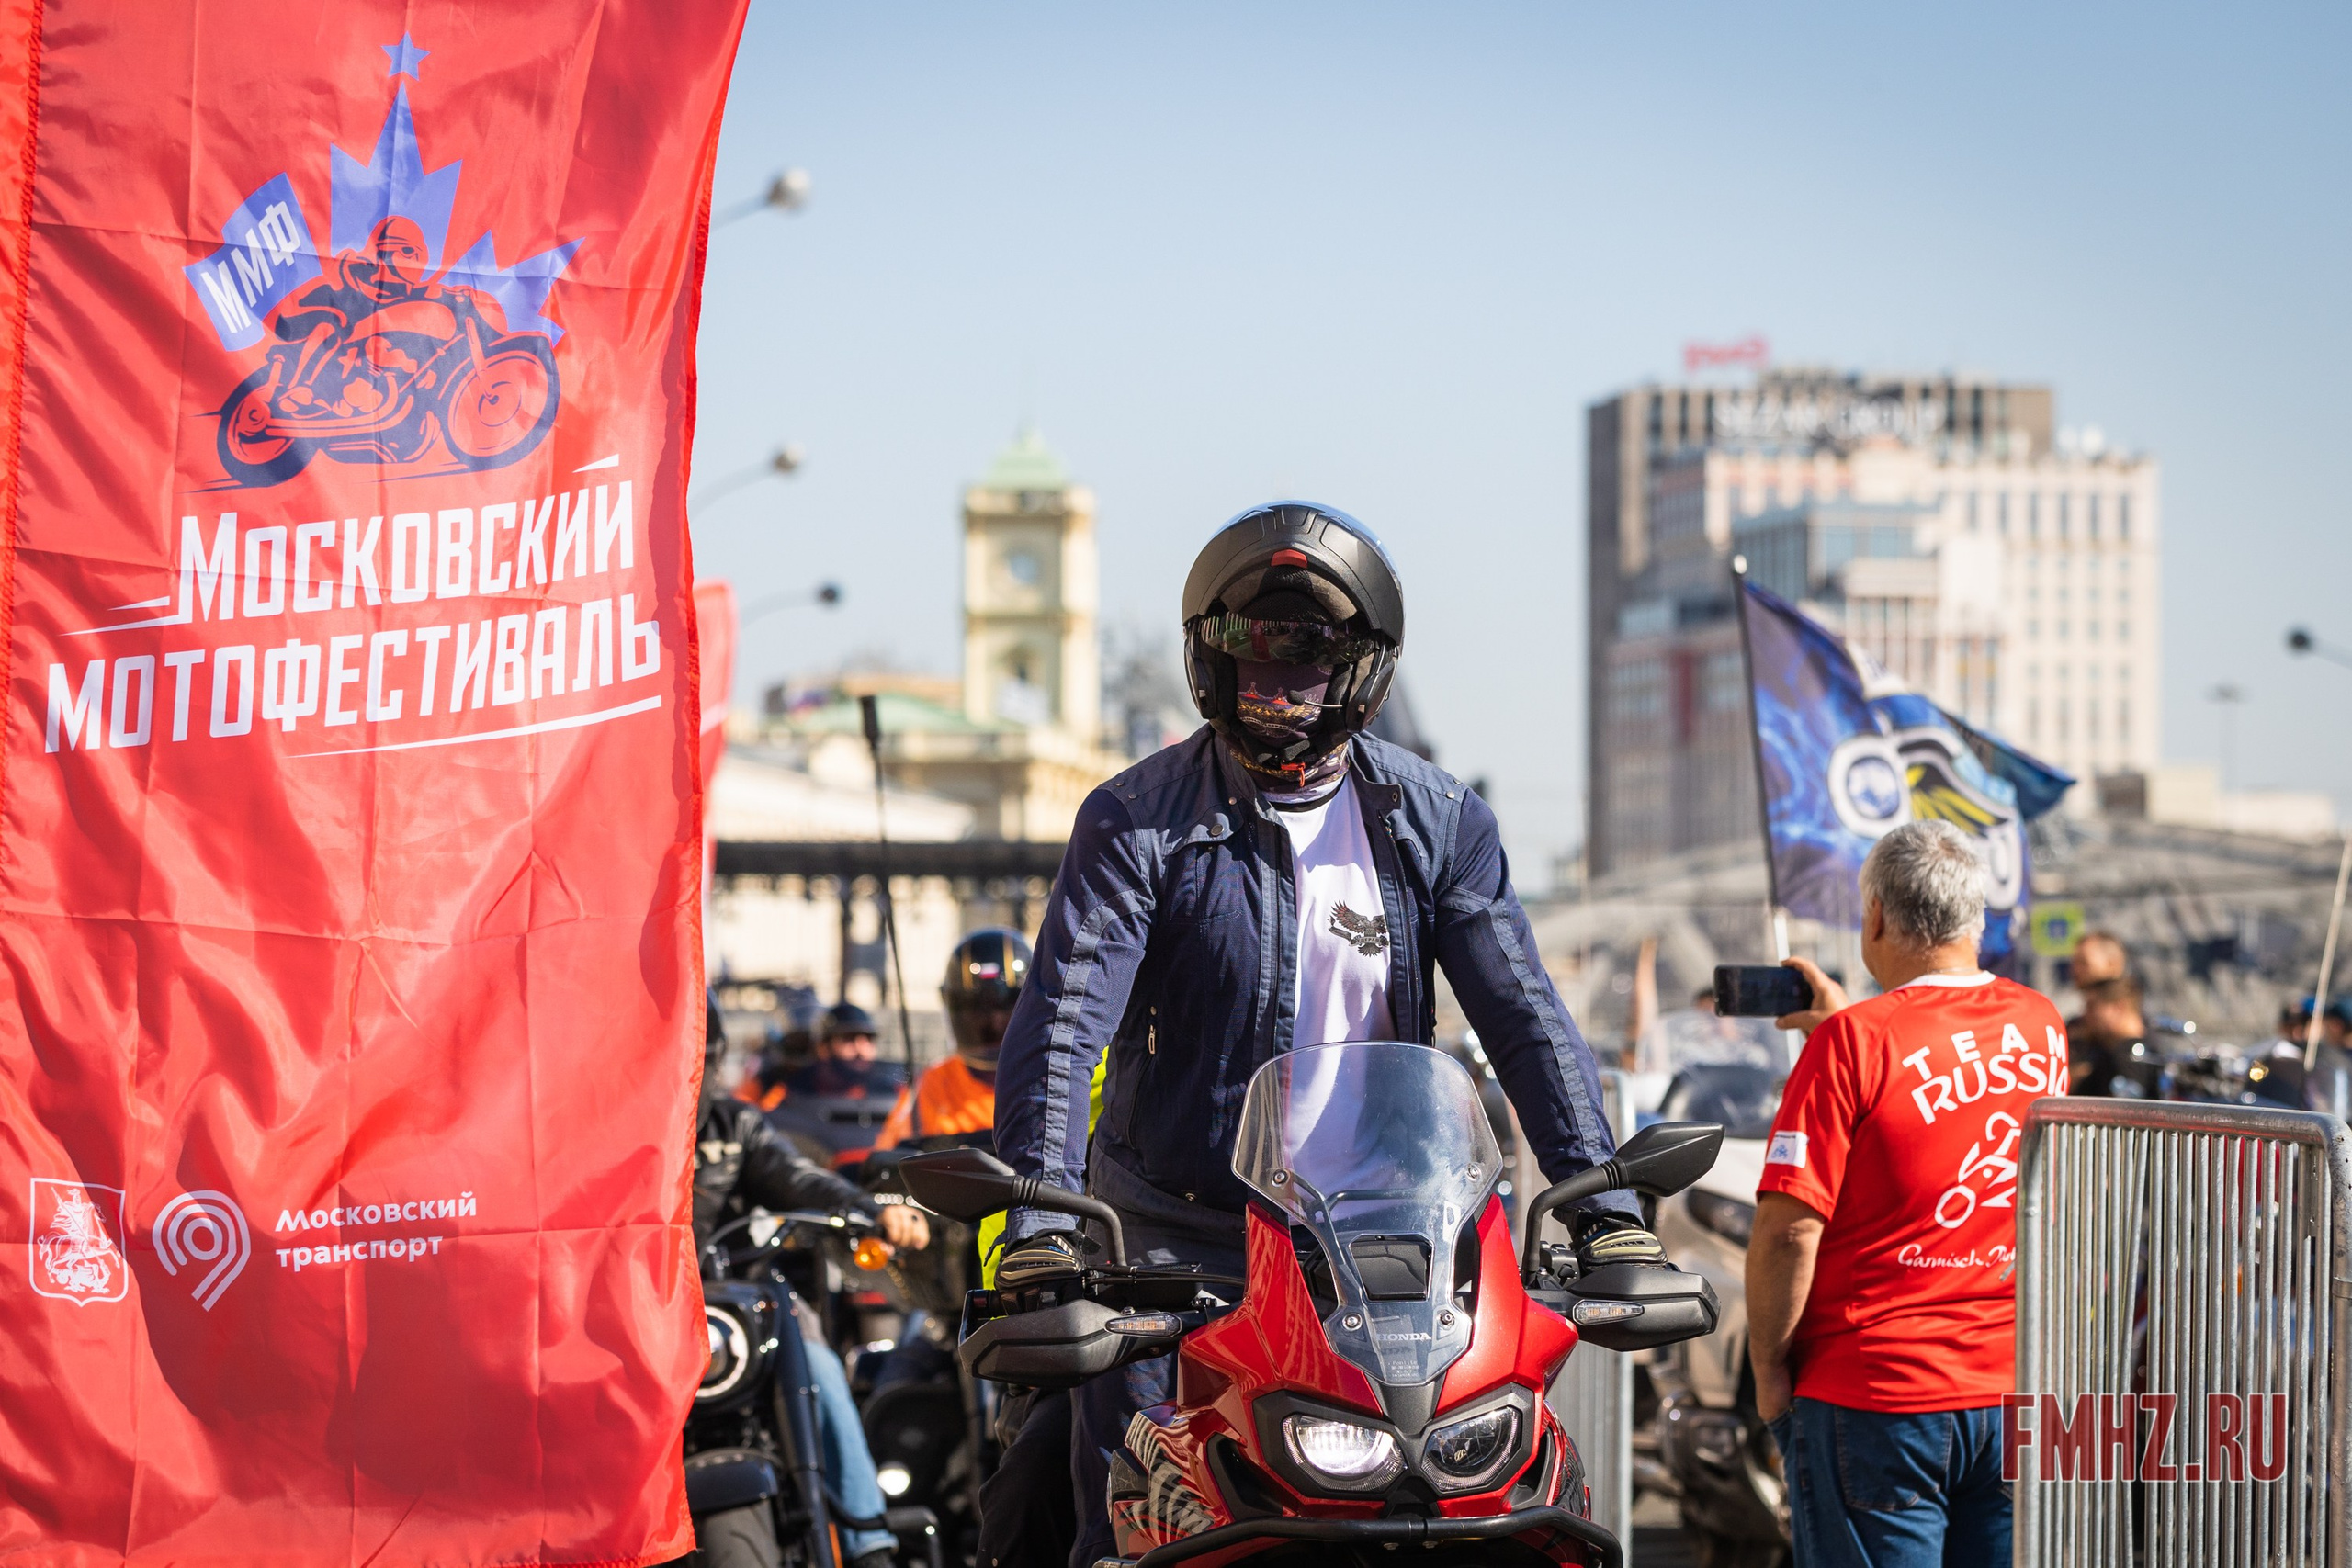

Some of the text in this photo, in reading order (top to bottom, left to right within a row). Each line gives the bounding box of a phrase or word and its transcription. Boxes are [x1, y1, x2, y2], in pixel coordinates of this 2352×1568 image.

[200, 201, 301, 333] ММФ
[45, 593, 662, 753] МОТОФЕСТИВАЛЬ
[1902, 1023, 2067, 1082] TEAM
[275, 1190, 477, 1233] Московский
[276, 1235, 444, 1273] транспорт
[1376, 1332, 1432, 1341] HONDA
